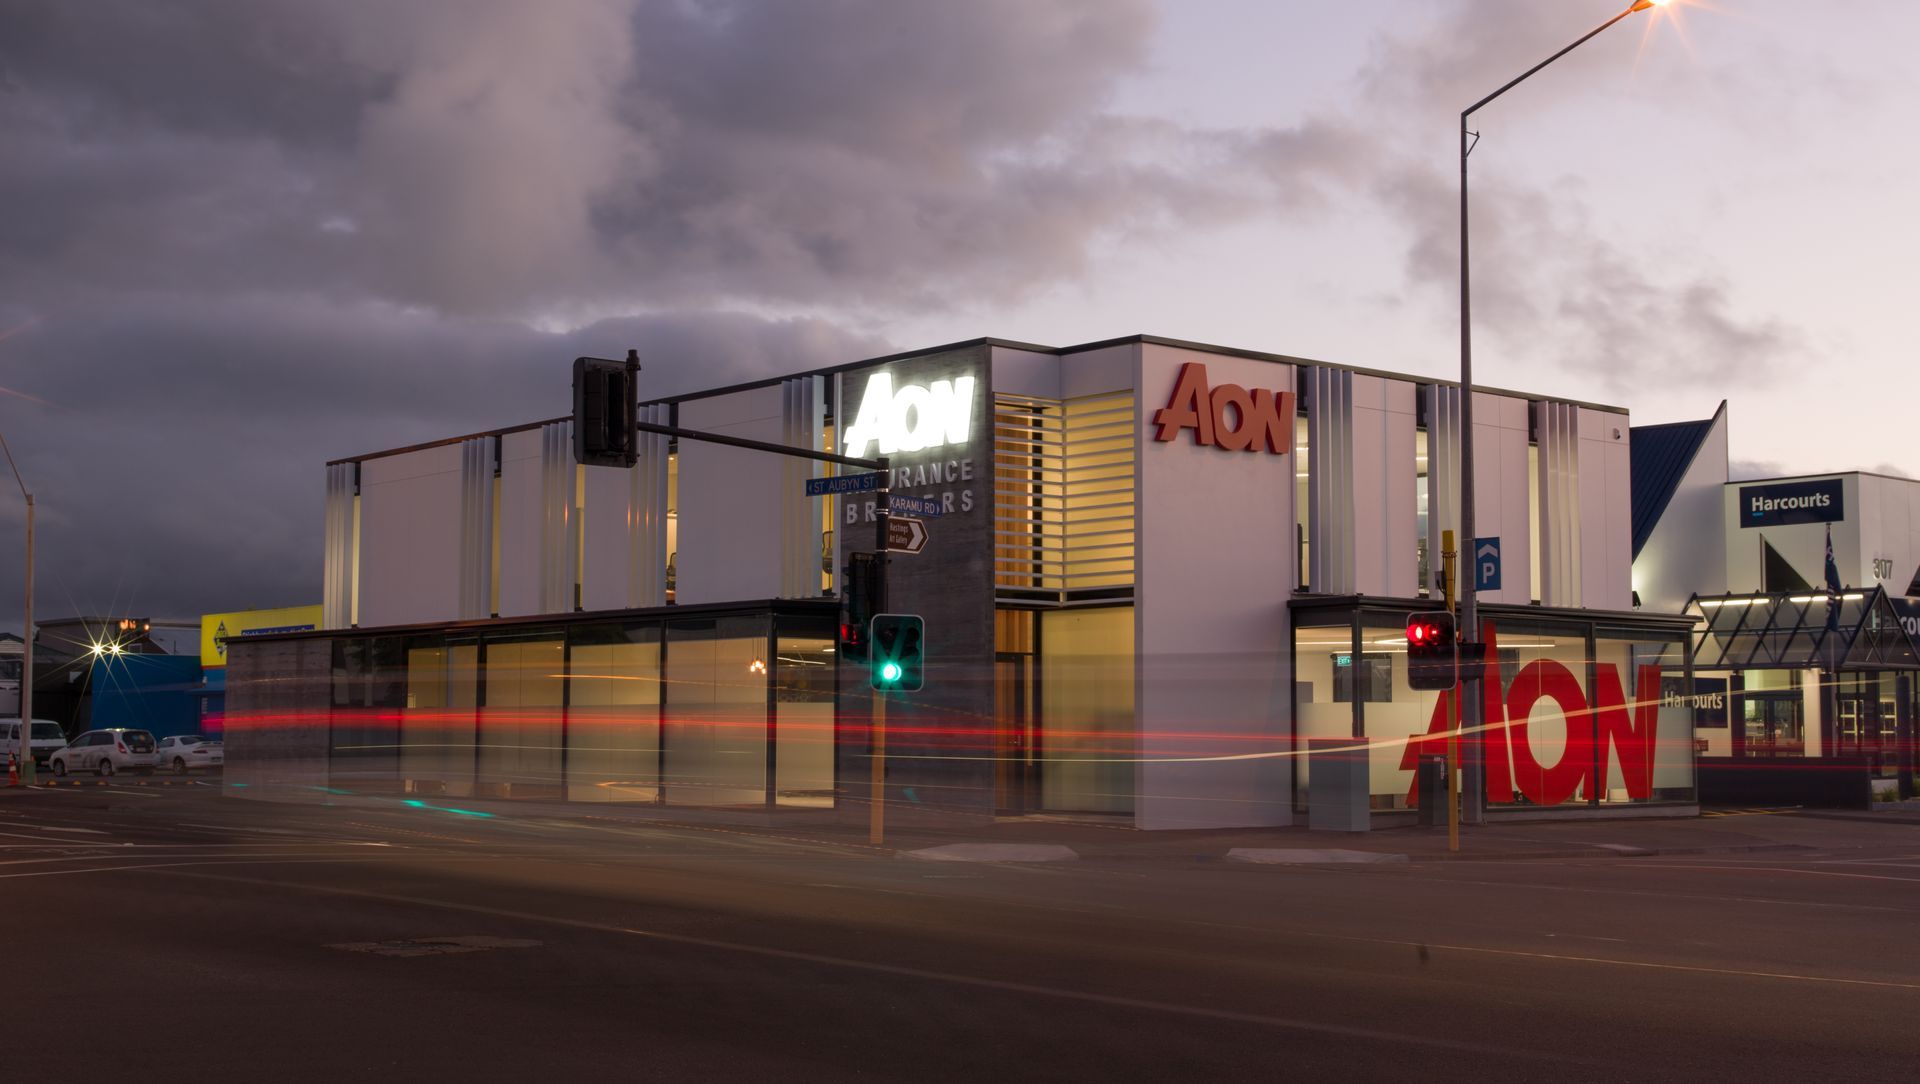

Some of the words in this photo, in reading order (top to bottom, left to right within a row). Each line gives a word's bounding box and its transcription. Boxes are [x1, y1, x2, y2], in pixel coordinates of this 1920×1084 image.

[814, 480, 825, 493] ST
[828, 478, 860, 492] AUBYN
[863, 476, 874, 488] ST
[846, 490, 974, 524] BRRS
[889, 496, 923, 512] KARAMU
[924, 501, 935, 514] RD
[1751, 493, 1830, 512] Harcourts
[889, 522, 909, 534] Hastings
[1482, 562, 1495, 584] P
[1873, 558, 1893, 580] 307
[1664, 690, 1723, 710] Harourts
